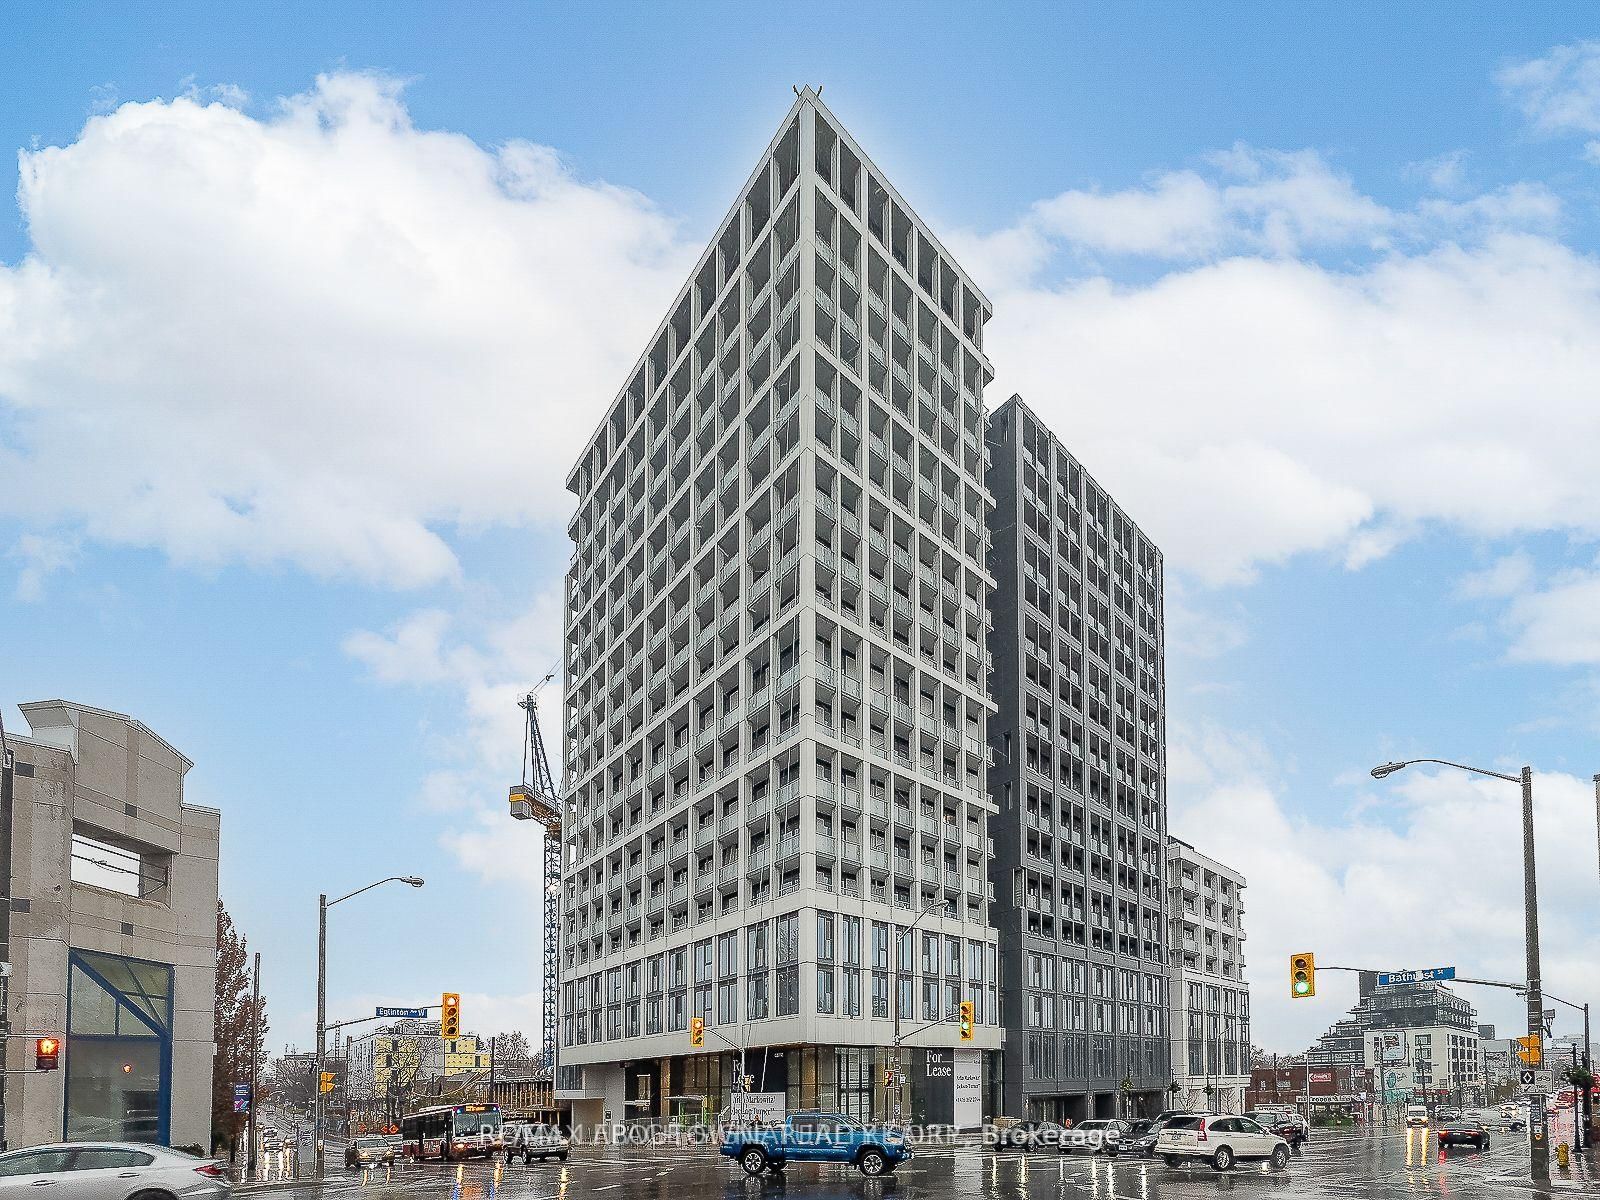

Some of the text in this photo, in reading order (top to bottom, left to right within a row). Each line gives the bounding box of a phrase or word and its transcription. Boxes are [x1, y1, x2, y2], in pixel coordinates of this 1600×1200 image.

[1388, 970, 1434, 982] Bathust
[380, 1008, 408, 1016] Eglinton
[926, 1050, 942, 1063] For
[926, 1064, 951, 1076] Lease
